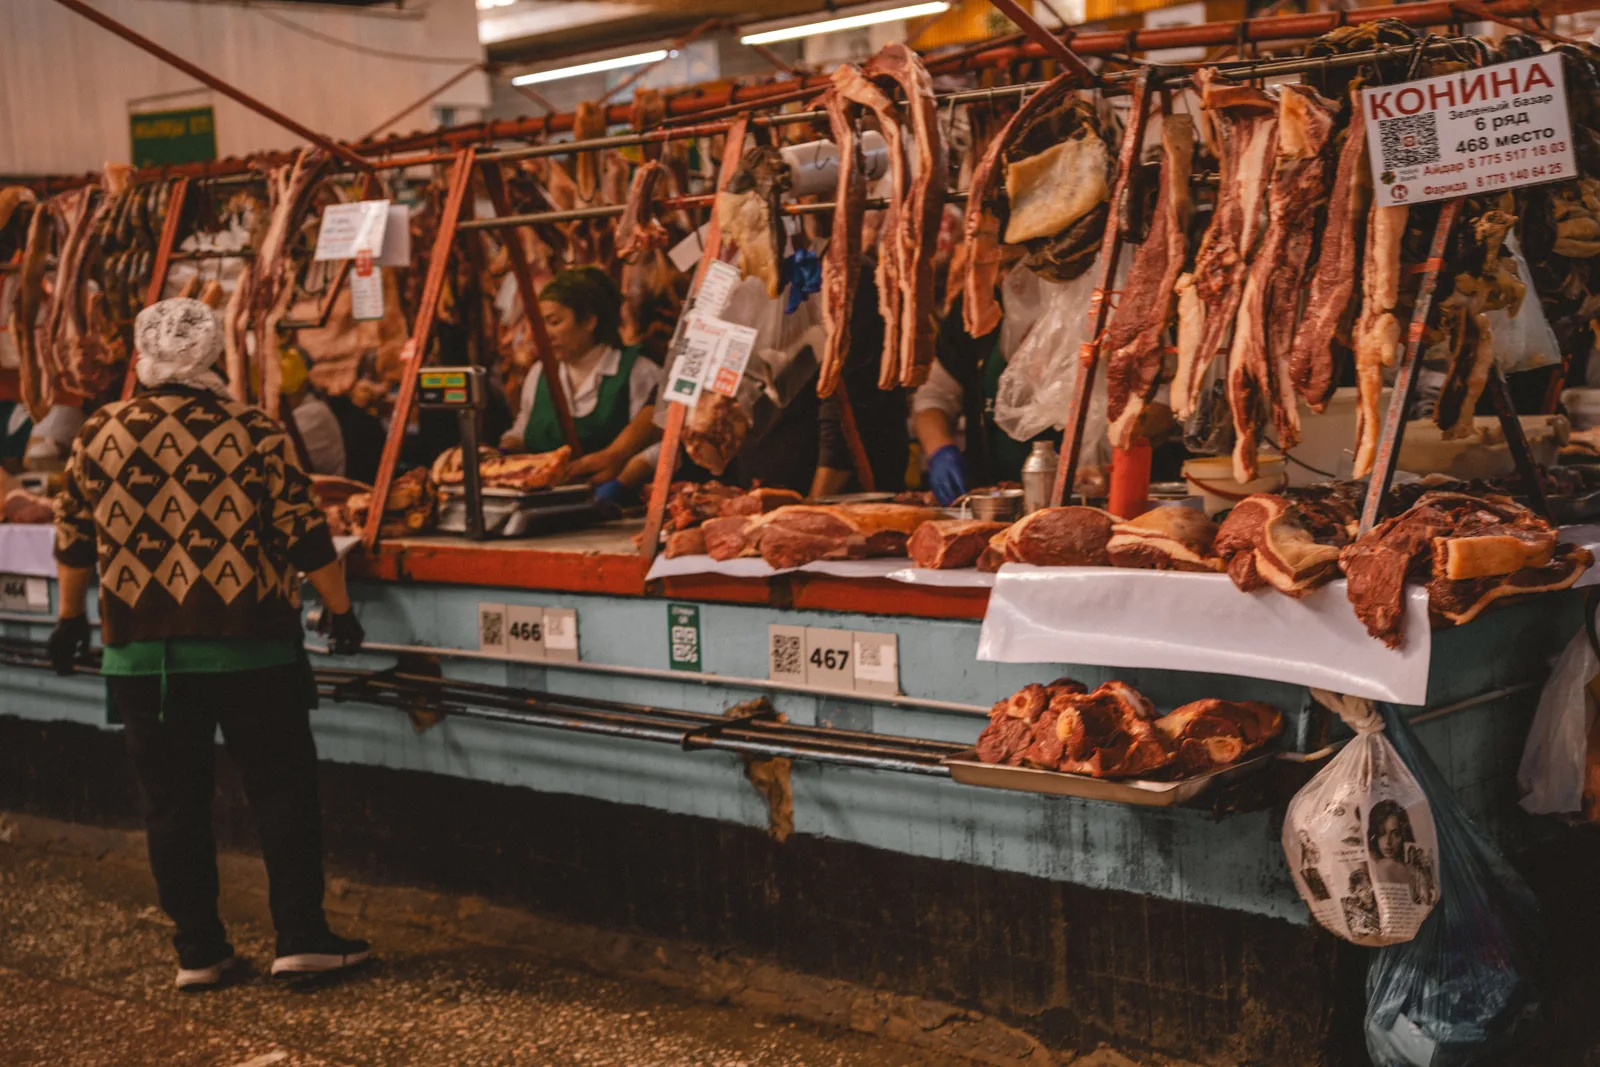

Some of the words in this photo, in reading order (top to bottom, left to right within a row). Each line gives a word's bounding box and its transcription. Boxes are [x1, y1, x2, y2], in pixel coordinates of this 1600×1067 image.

[1369, 63, 1555, 120] КОНИНА
[1449, 101, 1510, 120] Зеленый
[1513, 94, 1554, 108] базар
[1475, 117, 1486, 131] 6
[1492, 112, 1530, 131] ряд
[1456, 136, 1489, 154] 468
[1496, 128, 1555, 147] место
[1423, 162, 1465, 176] Айдар
[1468, 158, 1476, 169] 8
[1479, 153, 1502, 166] 775
[1505, 148, 1527, 161] 517
[1532, 145, 1547, 157] 18
[1550, 142, 1566, 154] 03
[1423, 182, 1469, 196] Фарида
[1476, 176, 1485, 187] 8
[1486, 173, 1507, 186] 778
[1510, 168, 1529, 181] 140
[1548, 162, 1563, 175] 25
[99, 433, 124, 461] A
[154, 432, 183, 458] A
[213, 432, 243, 458] A
[106, 500, 133, 528] A
[160, 495, 187, 523] A
[214, 495, 243, 521] A
[116, 565, 141, 591] A
[166, 560, 189, 586] A
[215, 560, 241, 586] A
[510, 621, 542, 642] 466
[809, 648, 850, 671] 467
